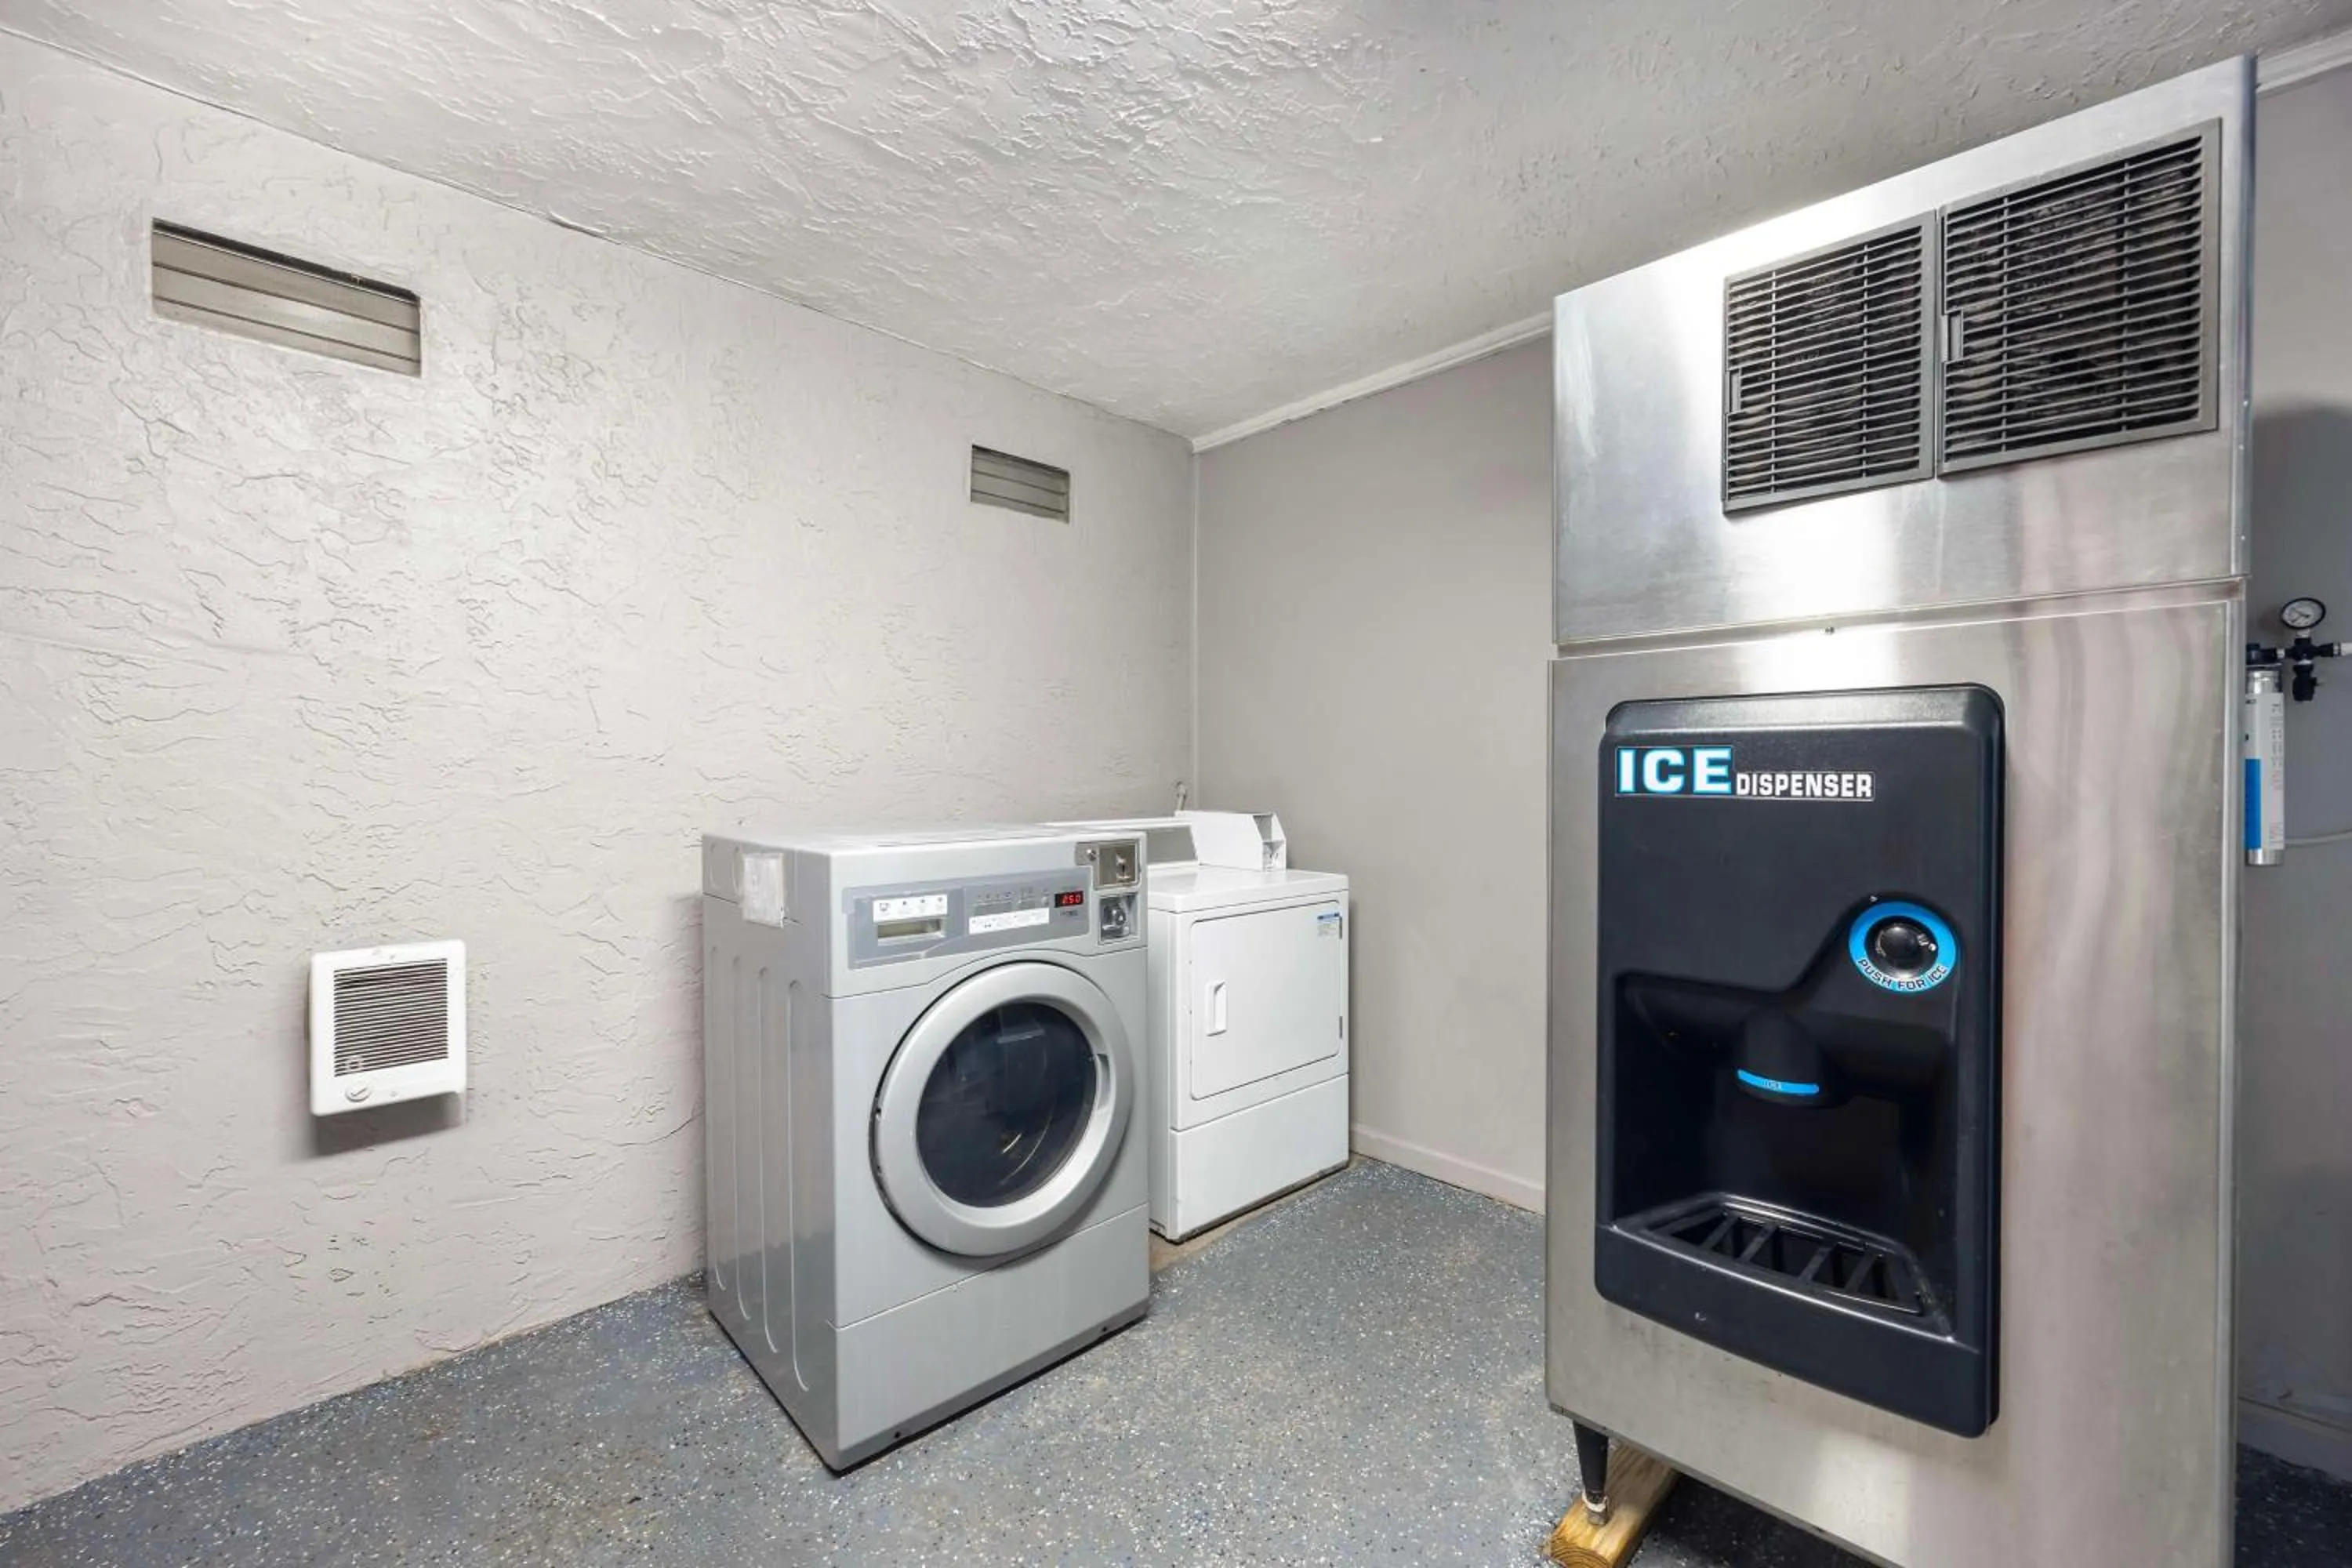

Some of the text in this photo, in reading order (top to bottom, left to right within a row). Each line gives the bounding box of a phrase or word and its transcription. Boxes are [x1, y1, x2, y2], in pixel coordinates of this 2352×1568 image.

[1619, 748, 1872, 797] ICE DISPENSER
[1858, 959, 1947, 990] PUSH FOR ICE
